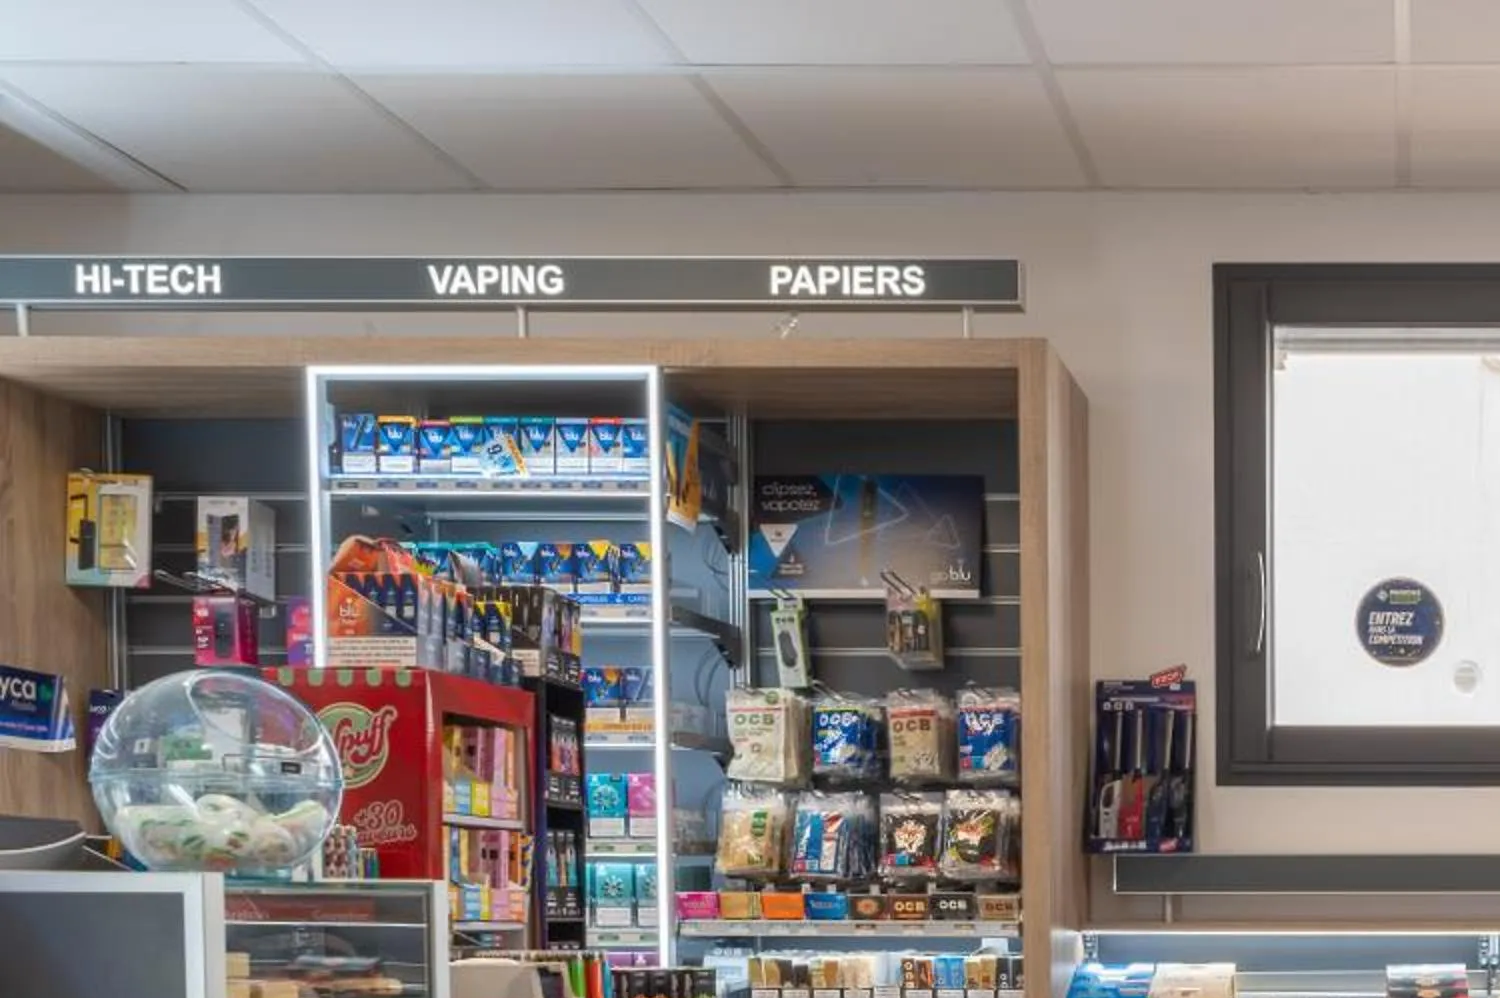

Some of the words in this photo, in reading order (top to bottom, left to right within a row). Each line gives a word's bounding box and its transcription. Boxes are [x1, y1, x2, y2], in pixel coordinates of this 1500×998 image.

[75, 264, 222, 295] HI-TECH
[428, 264, 565, 295] VAPING
[769, 265, 926, 296] PAPIERS
[1368, 611, 1415, 626] ENTREZ
[735, 713, 775, 726] OCB
[819, 712, 851, 727] OCB
[893, 719, 931, 733] OCB
[894, 901, 925, 912] OCB
[939, 899, 966, 910] OCB
